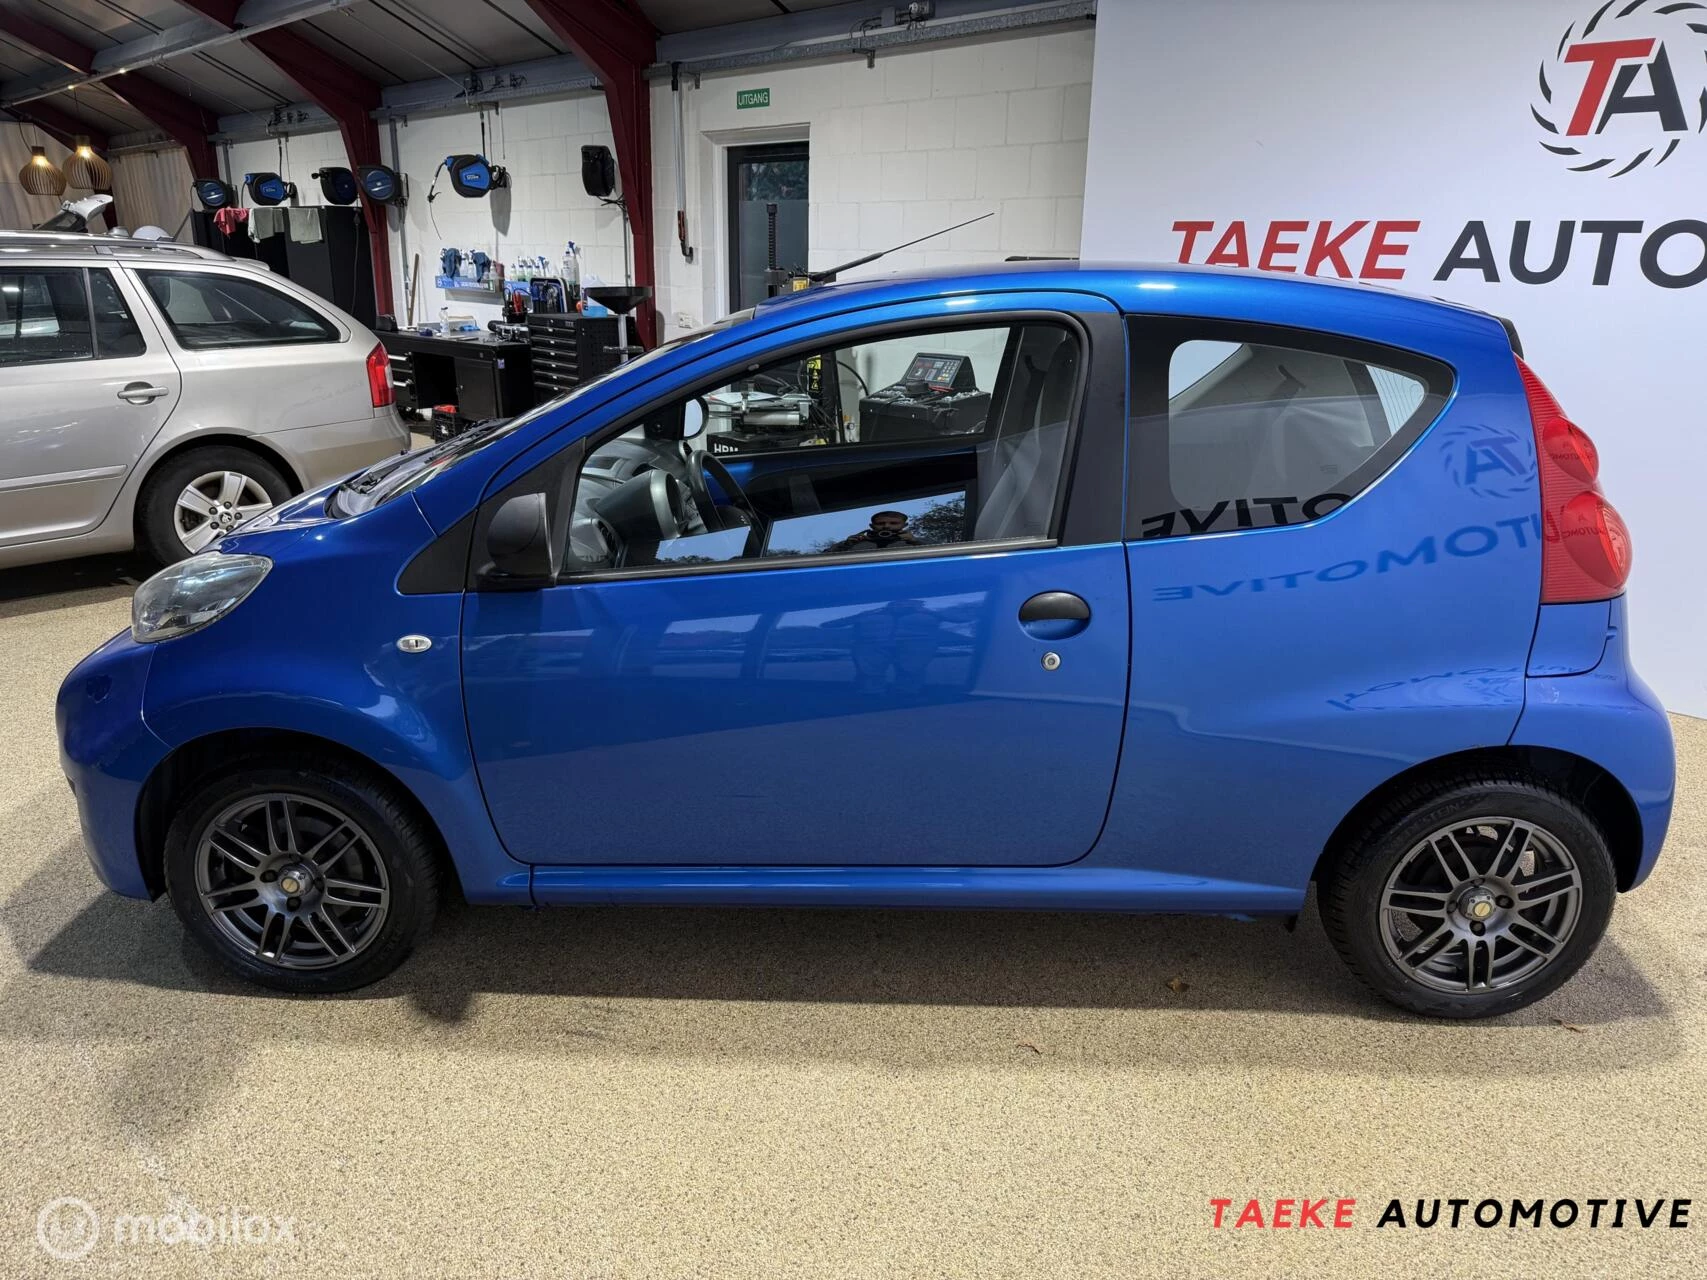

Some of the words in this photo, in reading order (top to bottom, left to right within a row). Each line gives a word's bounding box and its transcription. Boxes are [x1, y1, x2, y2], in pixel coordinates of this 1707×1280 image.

[738, 92, 769, 106] UITGANG
[1564, 38, 1689, 136] TA
[1172, 220, 1421, 280] TAEKE
[1433, 219, 1707, 289] AUTO
